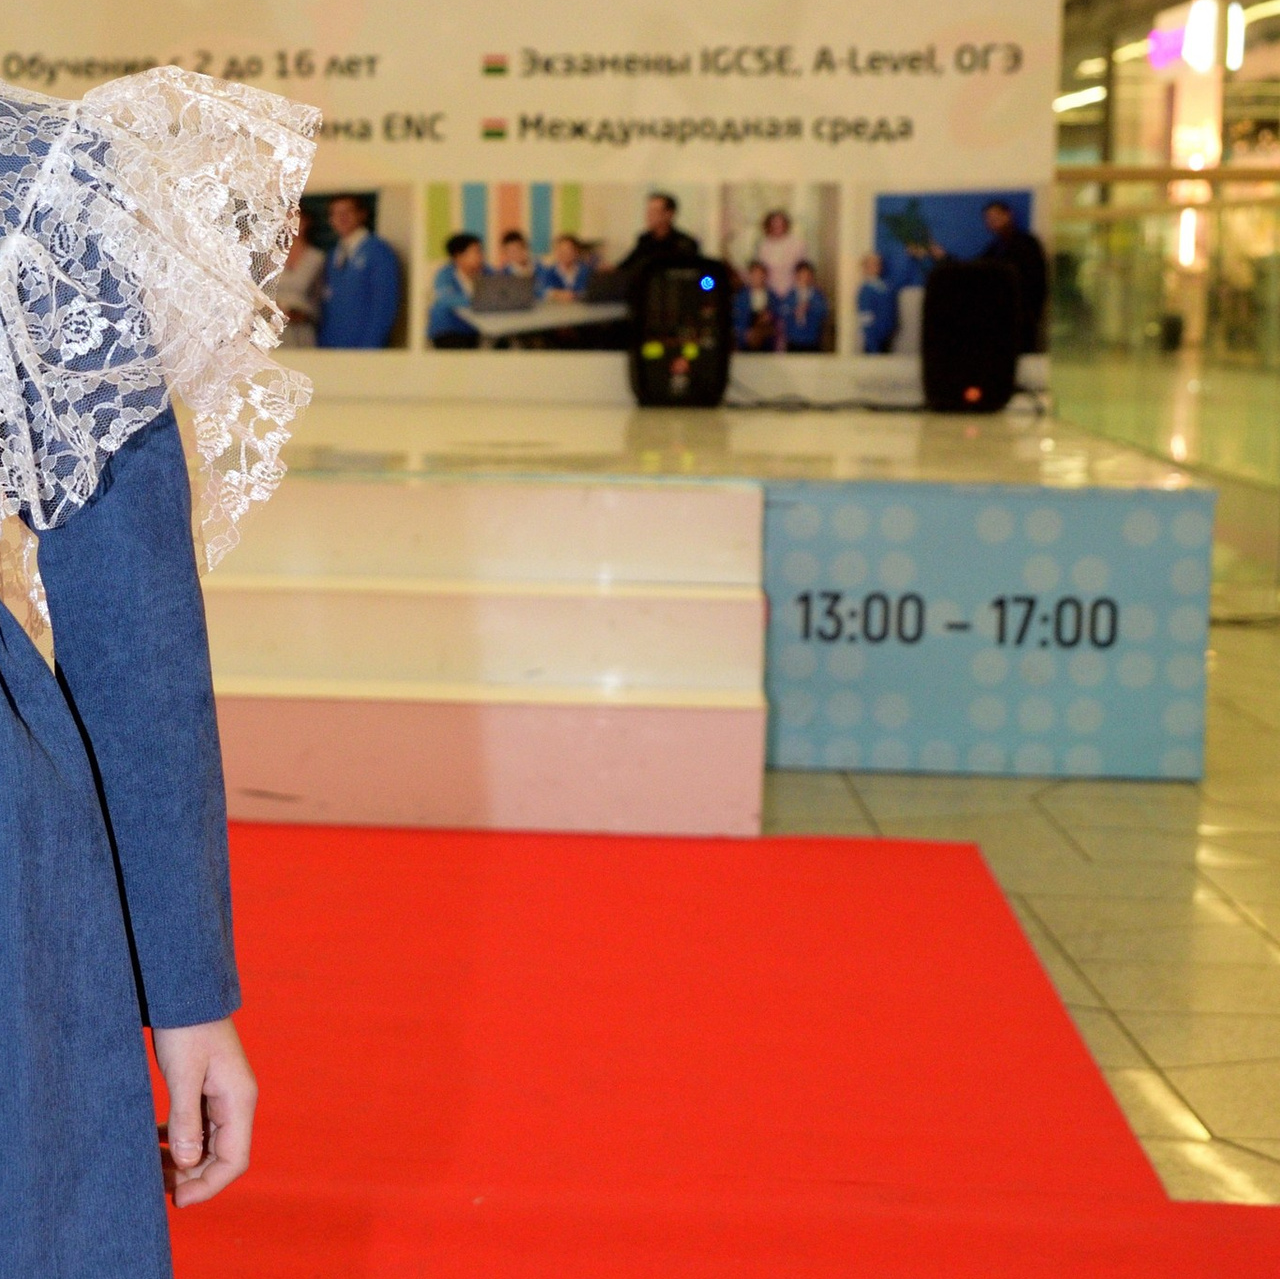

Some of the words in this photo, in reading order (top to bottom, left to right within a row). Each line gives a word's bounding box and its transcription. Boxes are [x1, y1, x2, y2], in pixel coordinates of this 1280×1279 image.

[194, 50, 214, 74] 2
[223, 54, 263, 80] до
[275, 48, 315, 78] 16
[325, 53, 381, 78] лет
[521, 49, 692, 78] Экзамены
[954, 42, 1023, 75] ОГЭ
[383, 111, 445, 141] ENC
[517, 111, 800, 148] Международная
[812, 112, 914, 146] среда
[796, 591, 924, 645] 13:00
[991, 595, 1119, 650] 17:00
